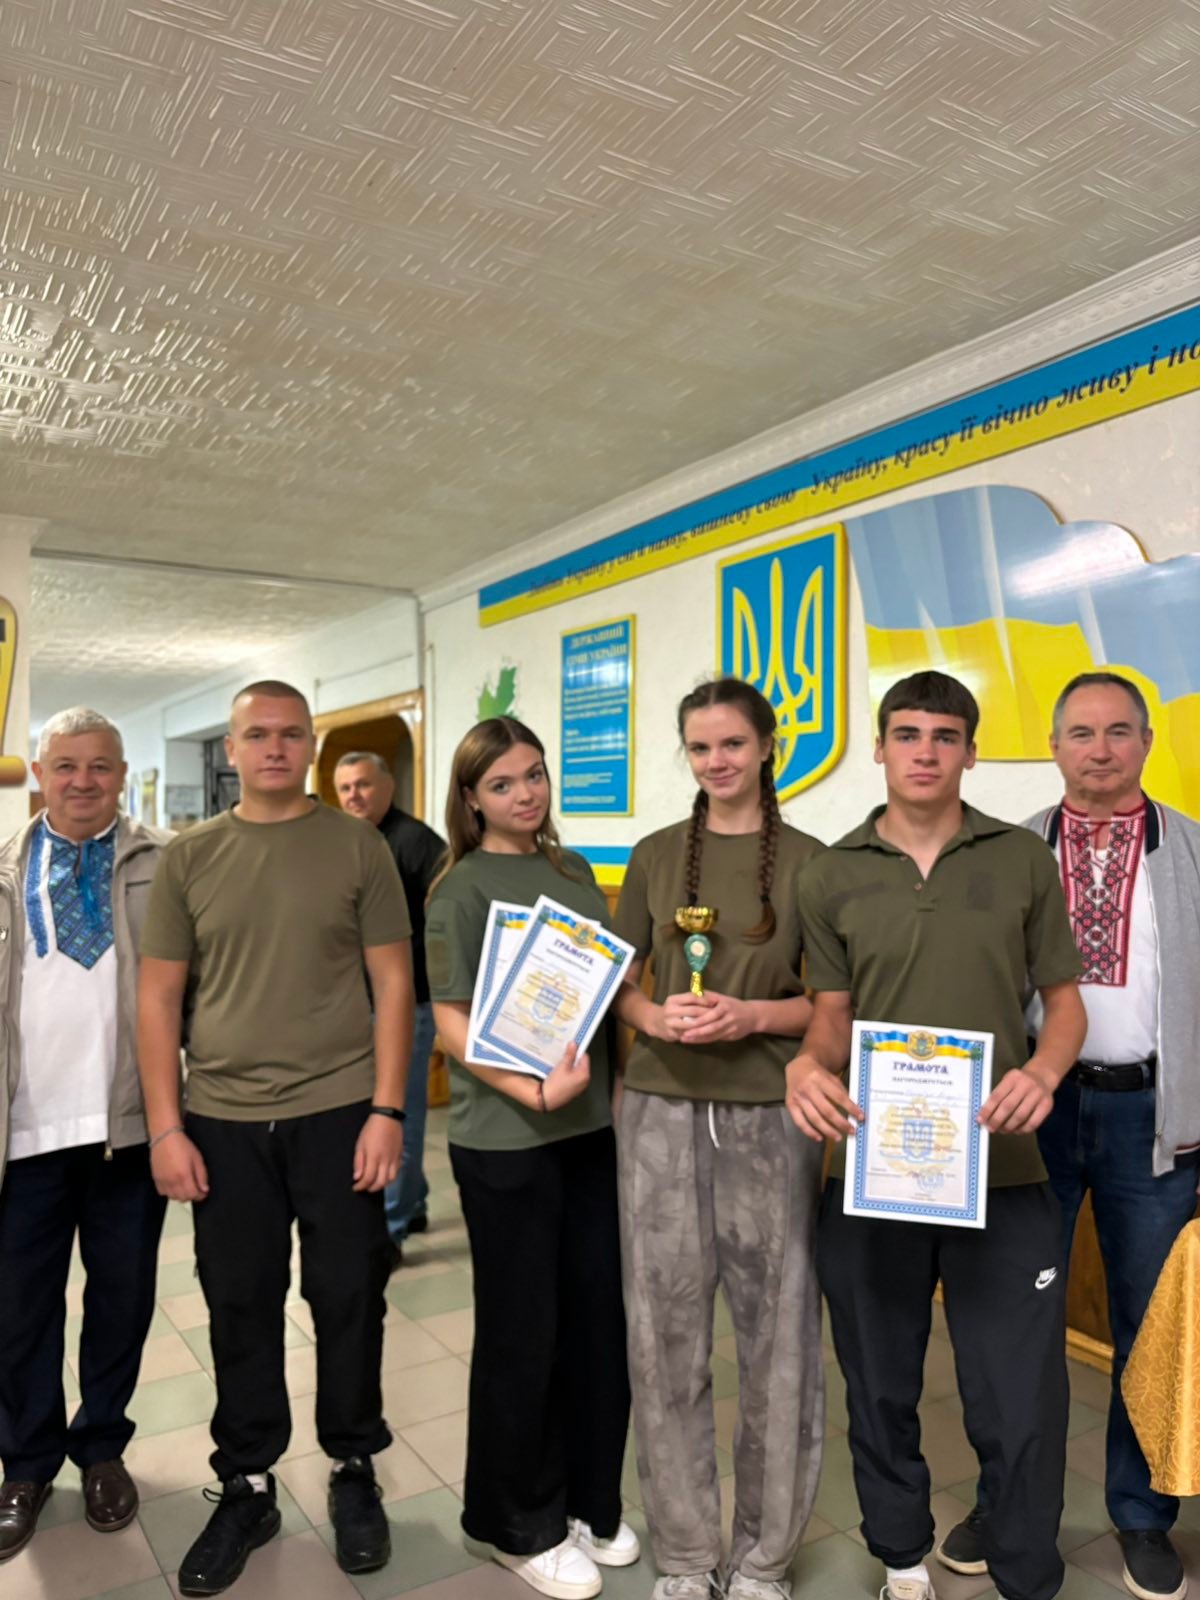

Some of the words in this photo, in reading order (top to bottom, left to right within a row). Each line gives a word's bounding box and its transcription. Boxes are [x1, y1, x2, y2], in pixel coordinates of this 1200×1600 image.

[810, 456, 887, 495] Україну,
[893, 430, 953, 469] красу
[959, 415, 978, 443] її
[981, 404, 1050, 434] вічно
[1056, 361, 1139, 408] живу
[1148, 344, 1159, 375] і
[892, 1061, 949, 1074] ГРАМОТА
